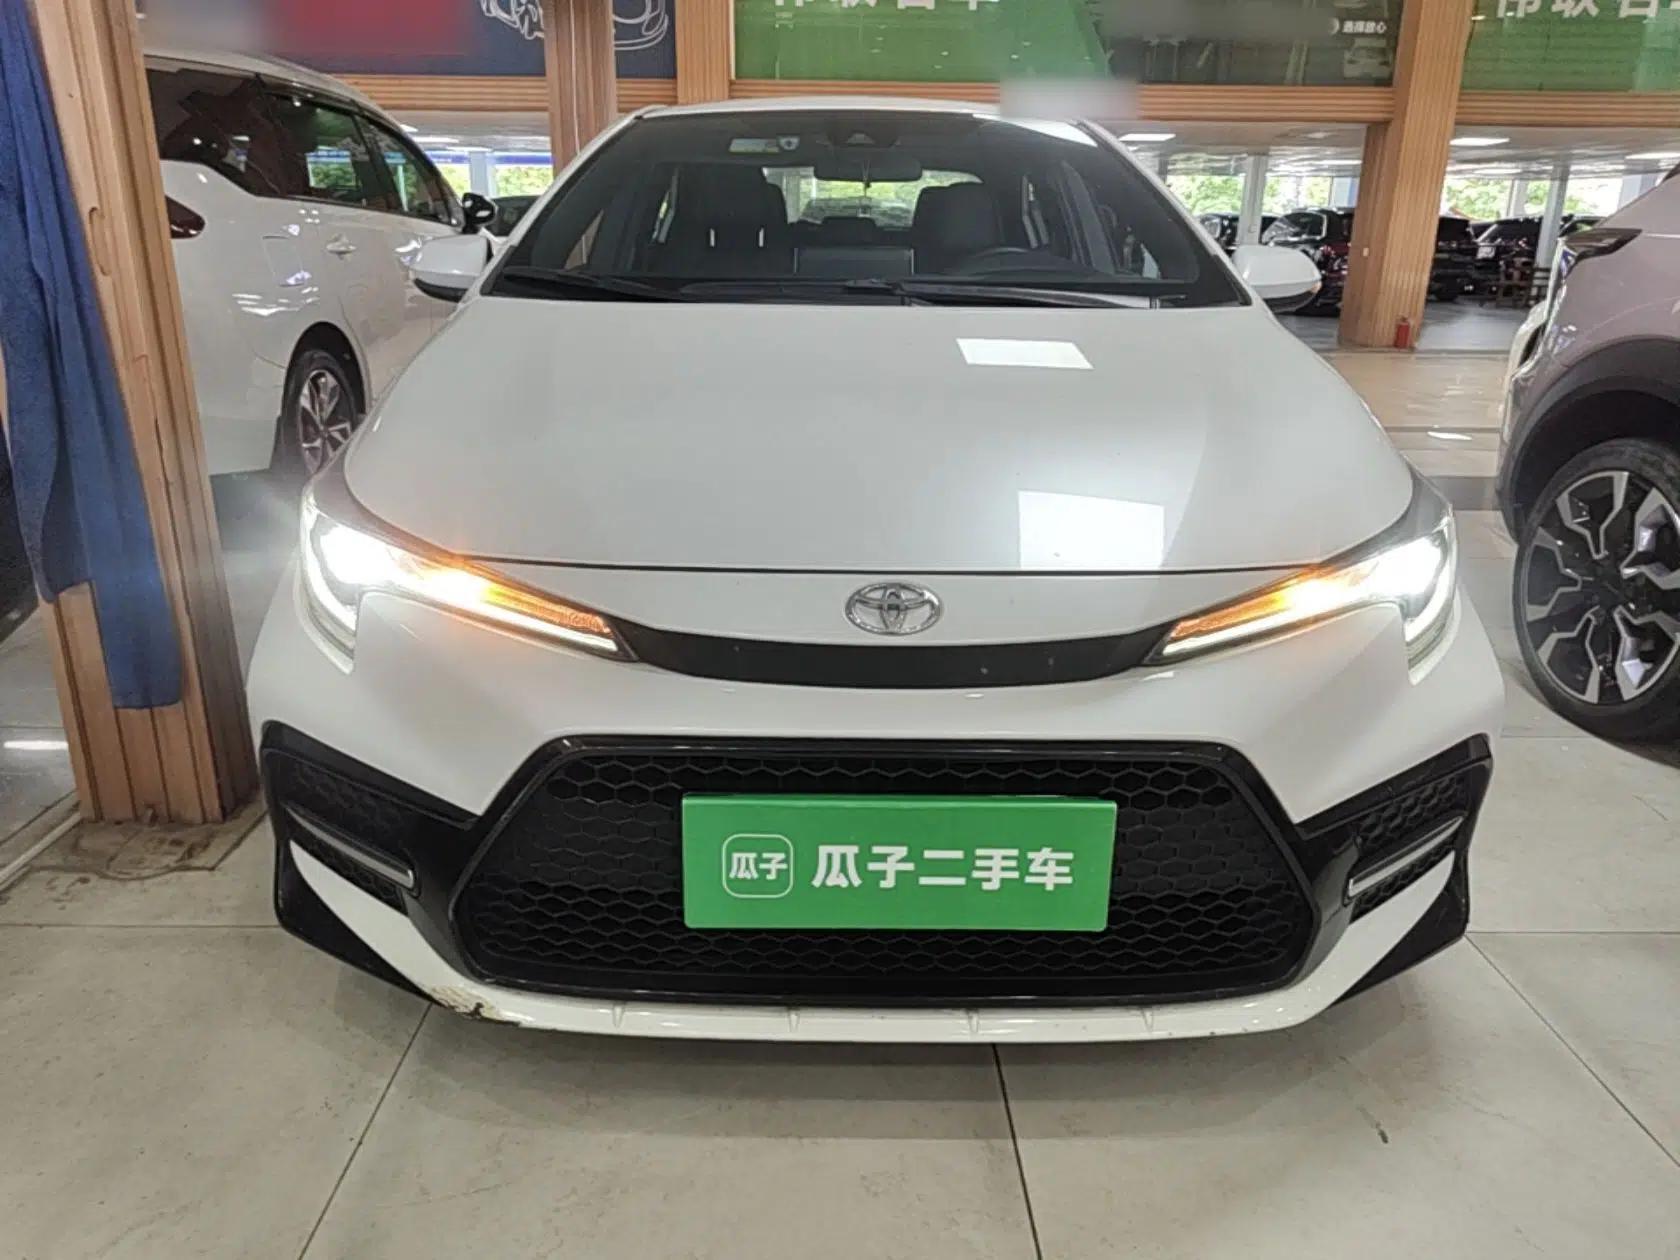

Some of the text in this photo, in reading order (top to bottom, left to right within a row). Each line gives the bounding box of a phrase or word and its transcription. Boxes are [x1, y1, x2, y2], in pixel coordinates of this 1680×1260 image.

[729, 852, 788, 880] 瓜子
[811, 845, 1074, 890] 瓜子二手车
